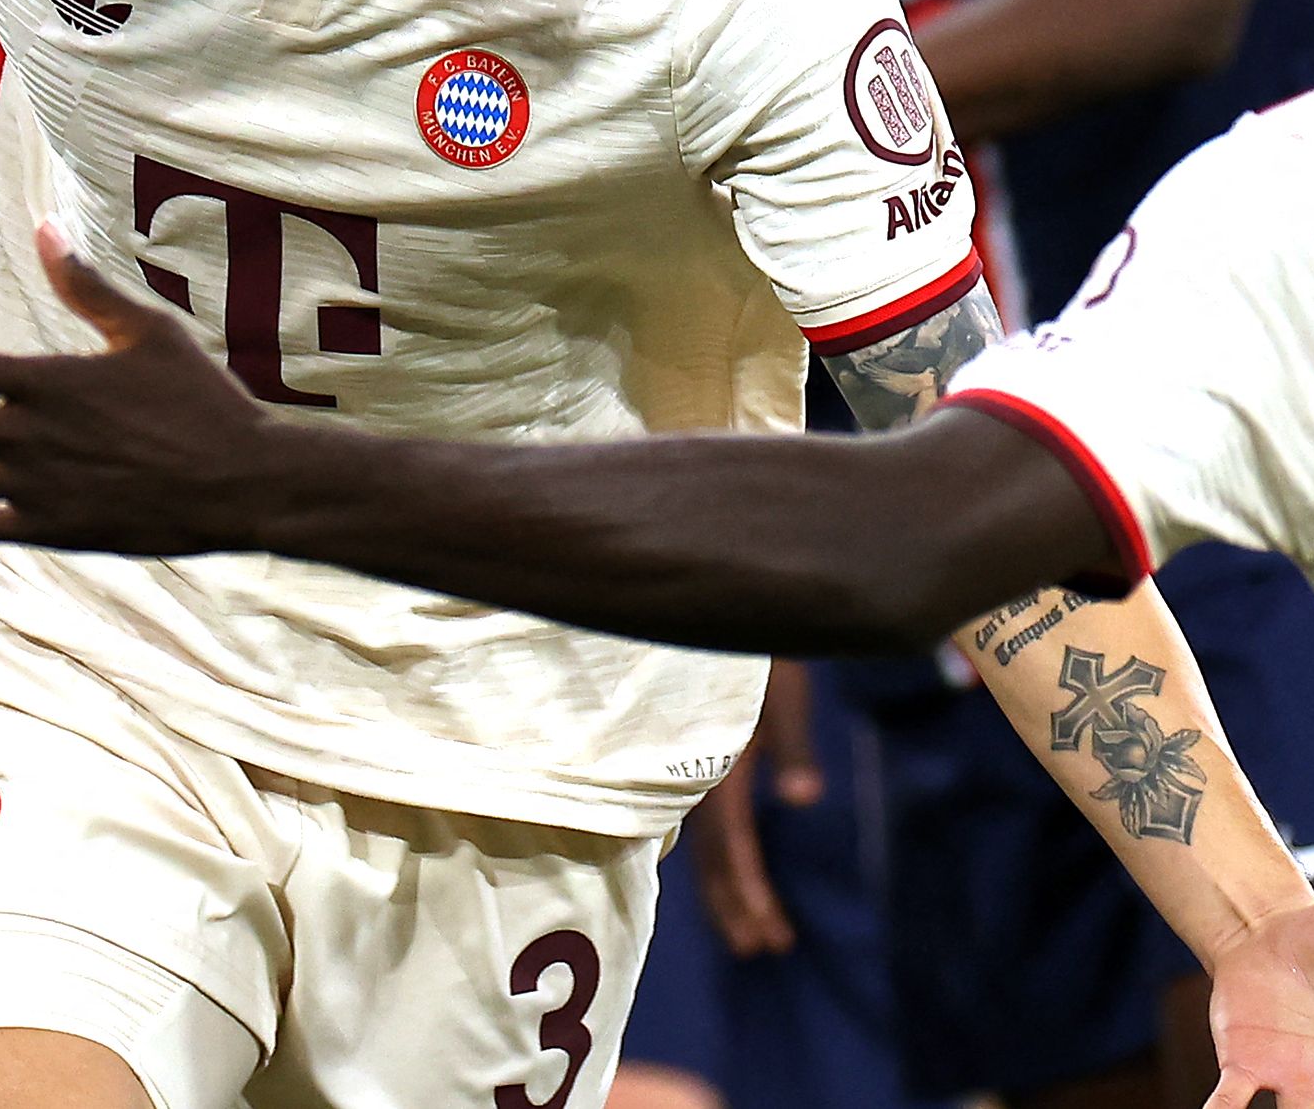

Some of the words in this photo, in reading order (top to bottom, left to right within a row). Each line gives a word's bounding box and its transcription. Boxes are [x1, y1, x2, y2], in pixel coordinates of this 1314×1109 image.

[467, 55, 523, 103] BAYERN
[421, 110, 492, 163] MÜNCHEN
[882, 141, 964, 241] Allian
[134, 154, 380, 407] T
[494, 929, 600, 1109] 3
